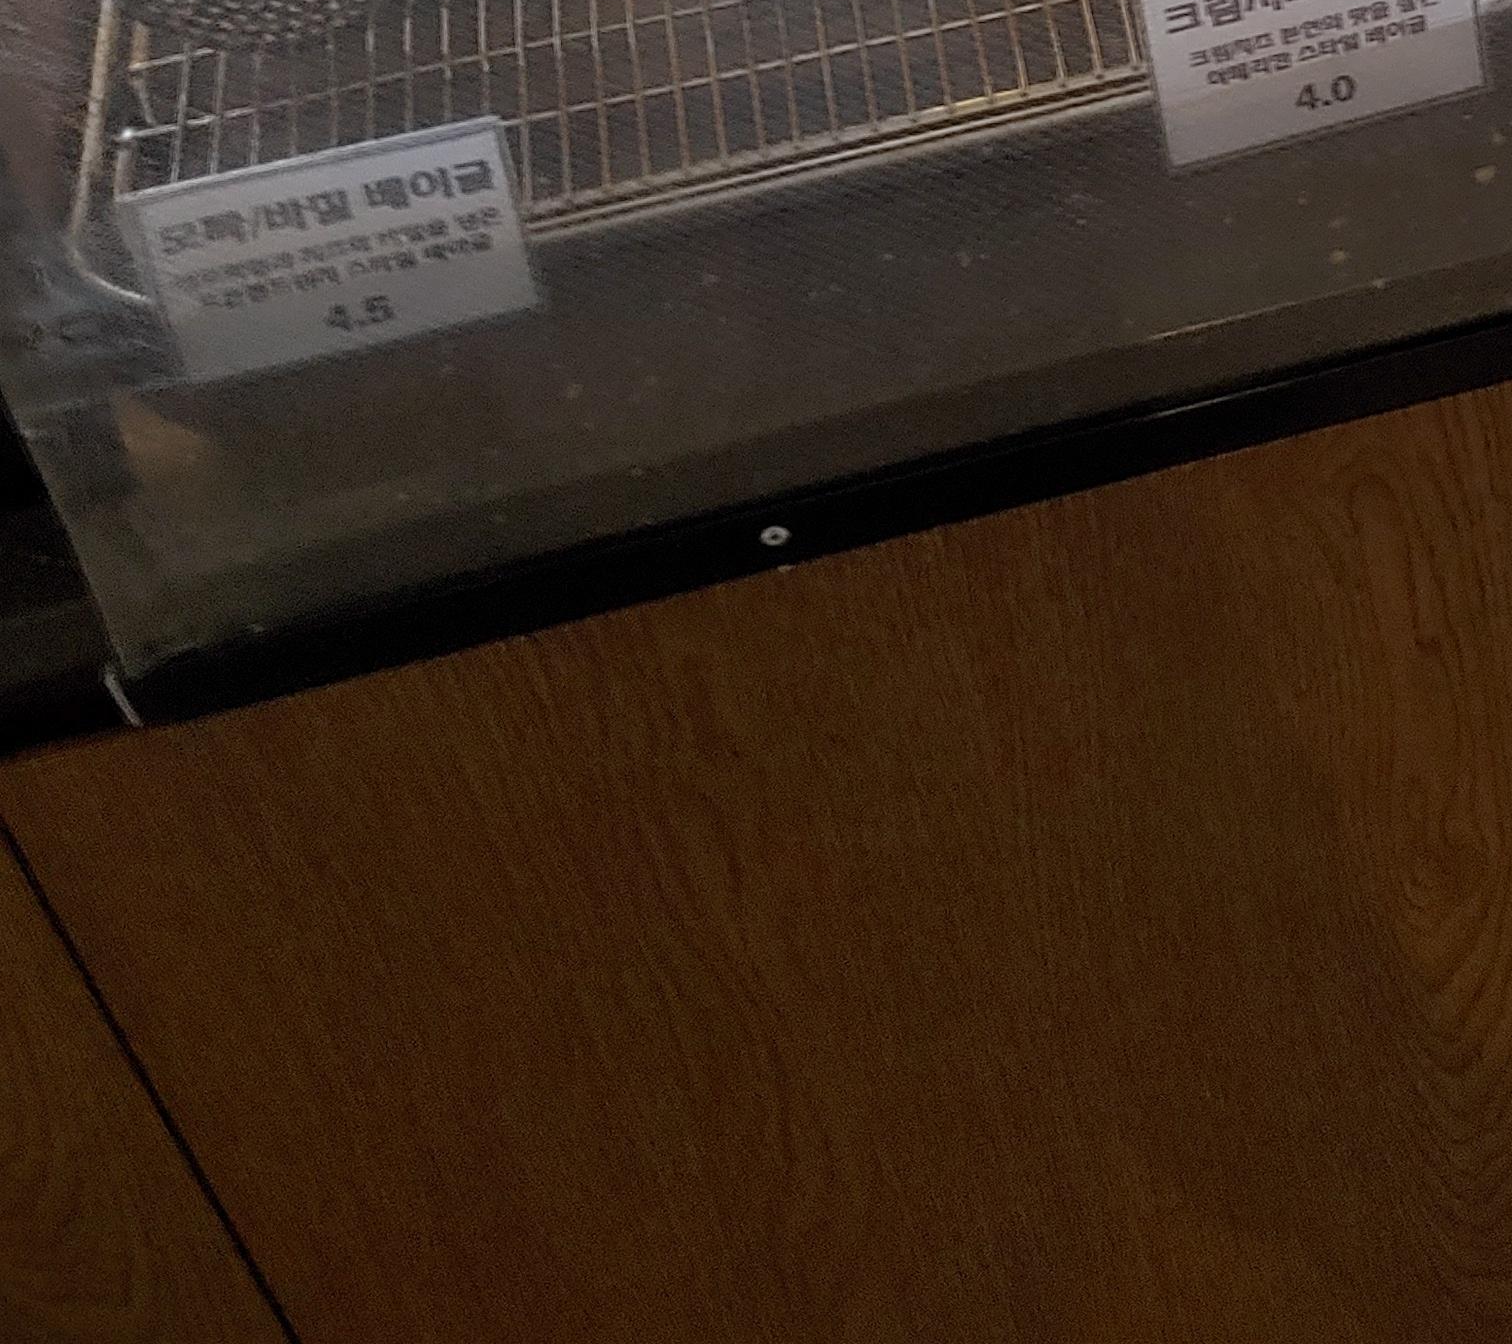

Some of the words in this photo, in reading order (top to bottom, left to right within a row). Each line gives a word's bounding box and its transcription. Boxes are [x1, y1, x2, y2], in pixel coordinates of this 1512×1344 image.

[1189, 32, 1275, 68] 크림치즈
[1347, 0, 1390, 25] 맛을
[1298, 32, 1361, 63] 스타일
[1365, 15, 1428, 43] 베이글
[1295, 74, 1357, 110] 4.0
[364, 158, 495, 210] 베이글
[324, 294, 396, 331] 4.5
